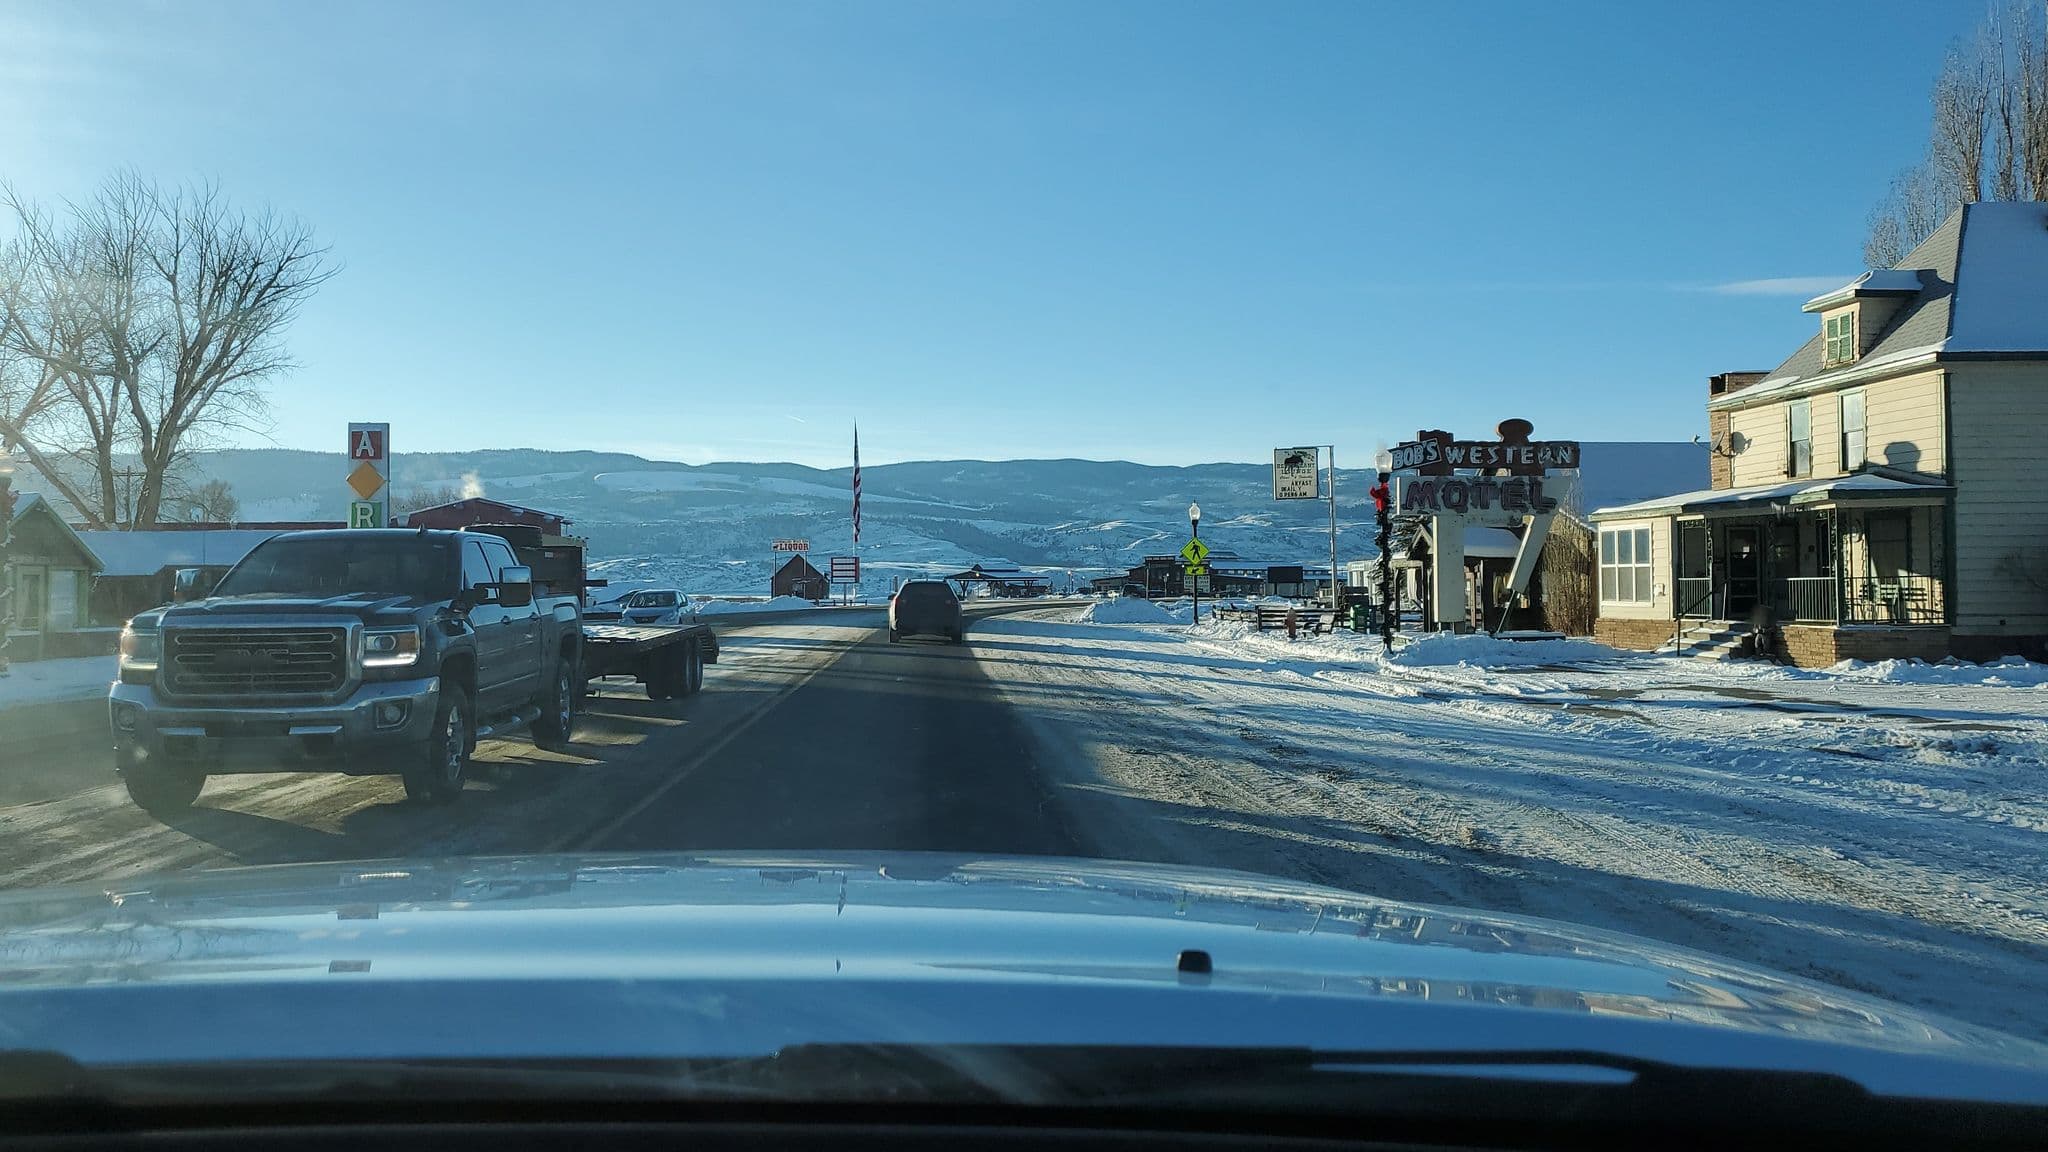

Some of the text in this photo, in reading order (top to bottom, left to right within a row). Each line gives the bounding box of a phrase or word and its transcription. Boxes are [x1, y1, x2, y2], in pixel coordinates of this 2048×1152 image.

[356, 430, 375, 457] A
[1392, 441, 1573, 470] BOB'S WESTERN
[1405, 480, 1558, 511] MOTEL
[355, 502, 375, 528] R
[779, 543, 809, 551] LIQUOR
